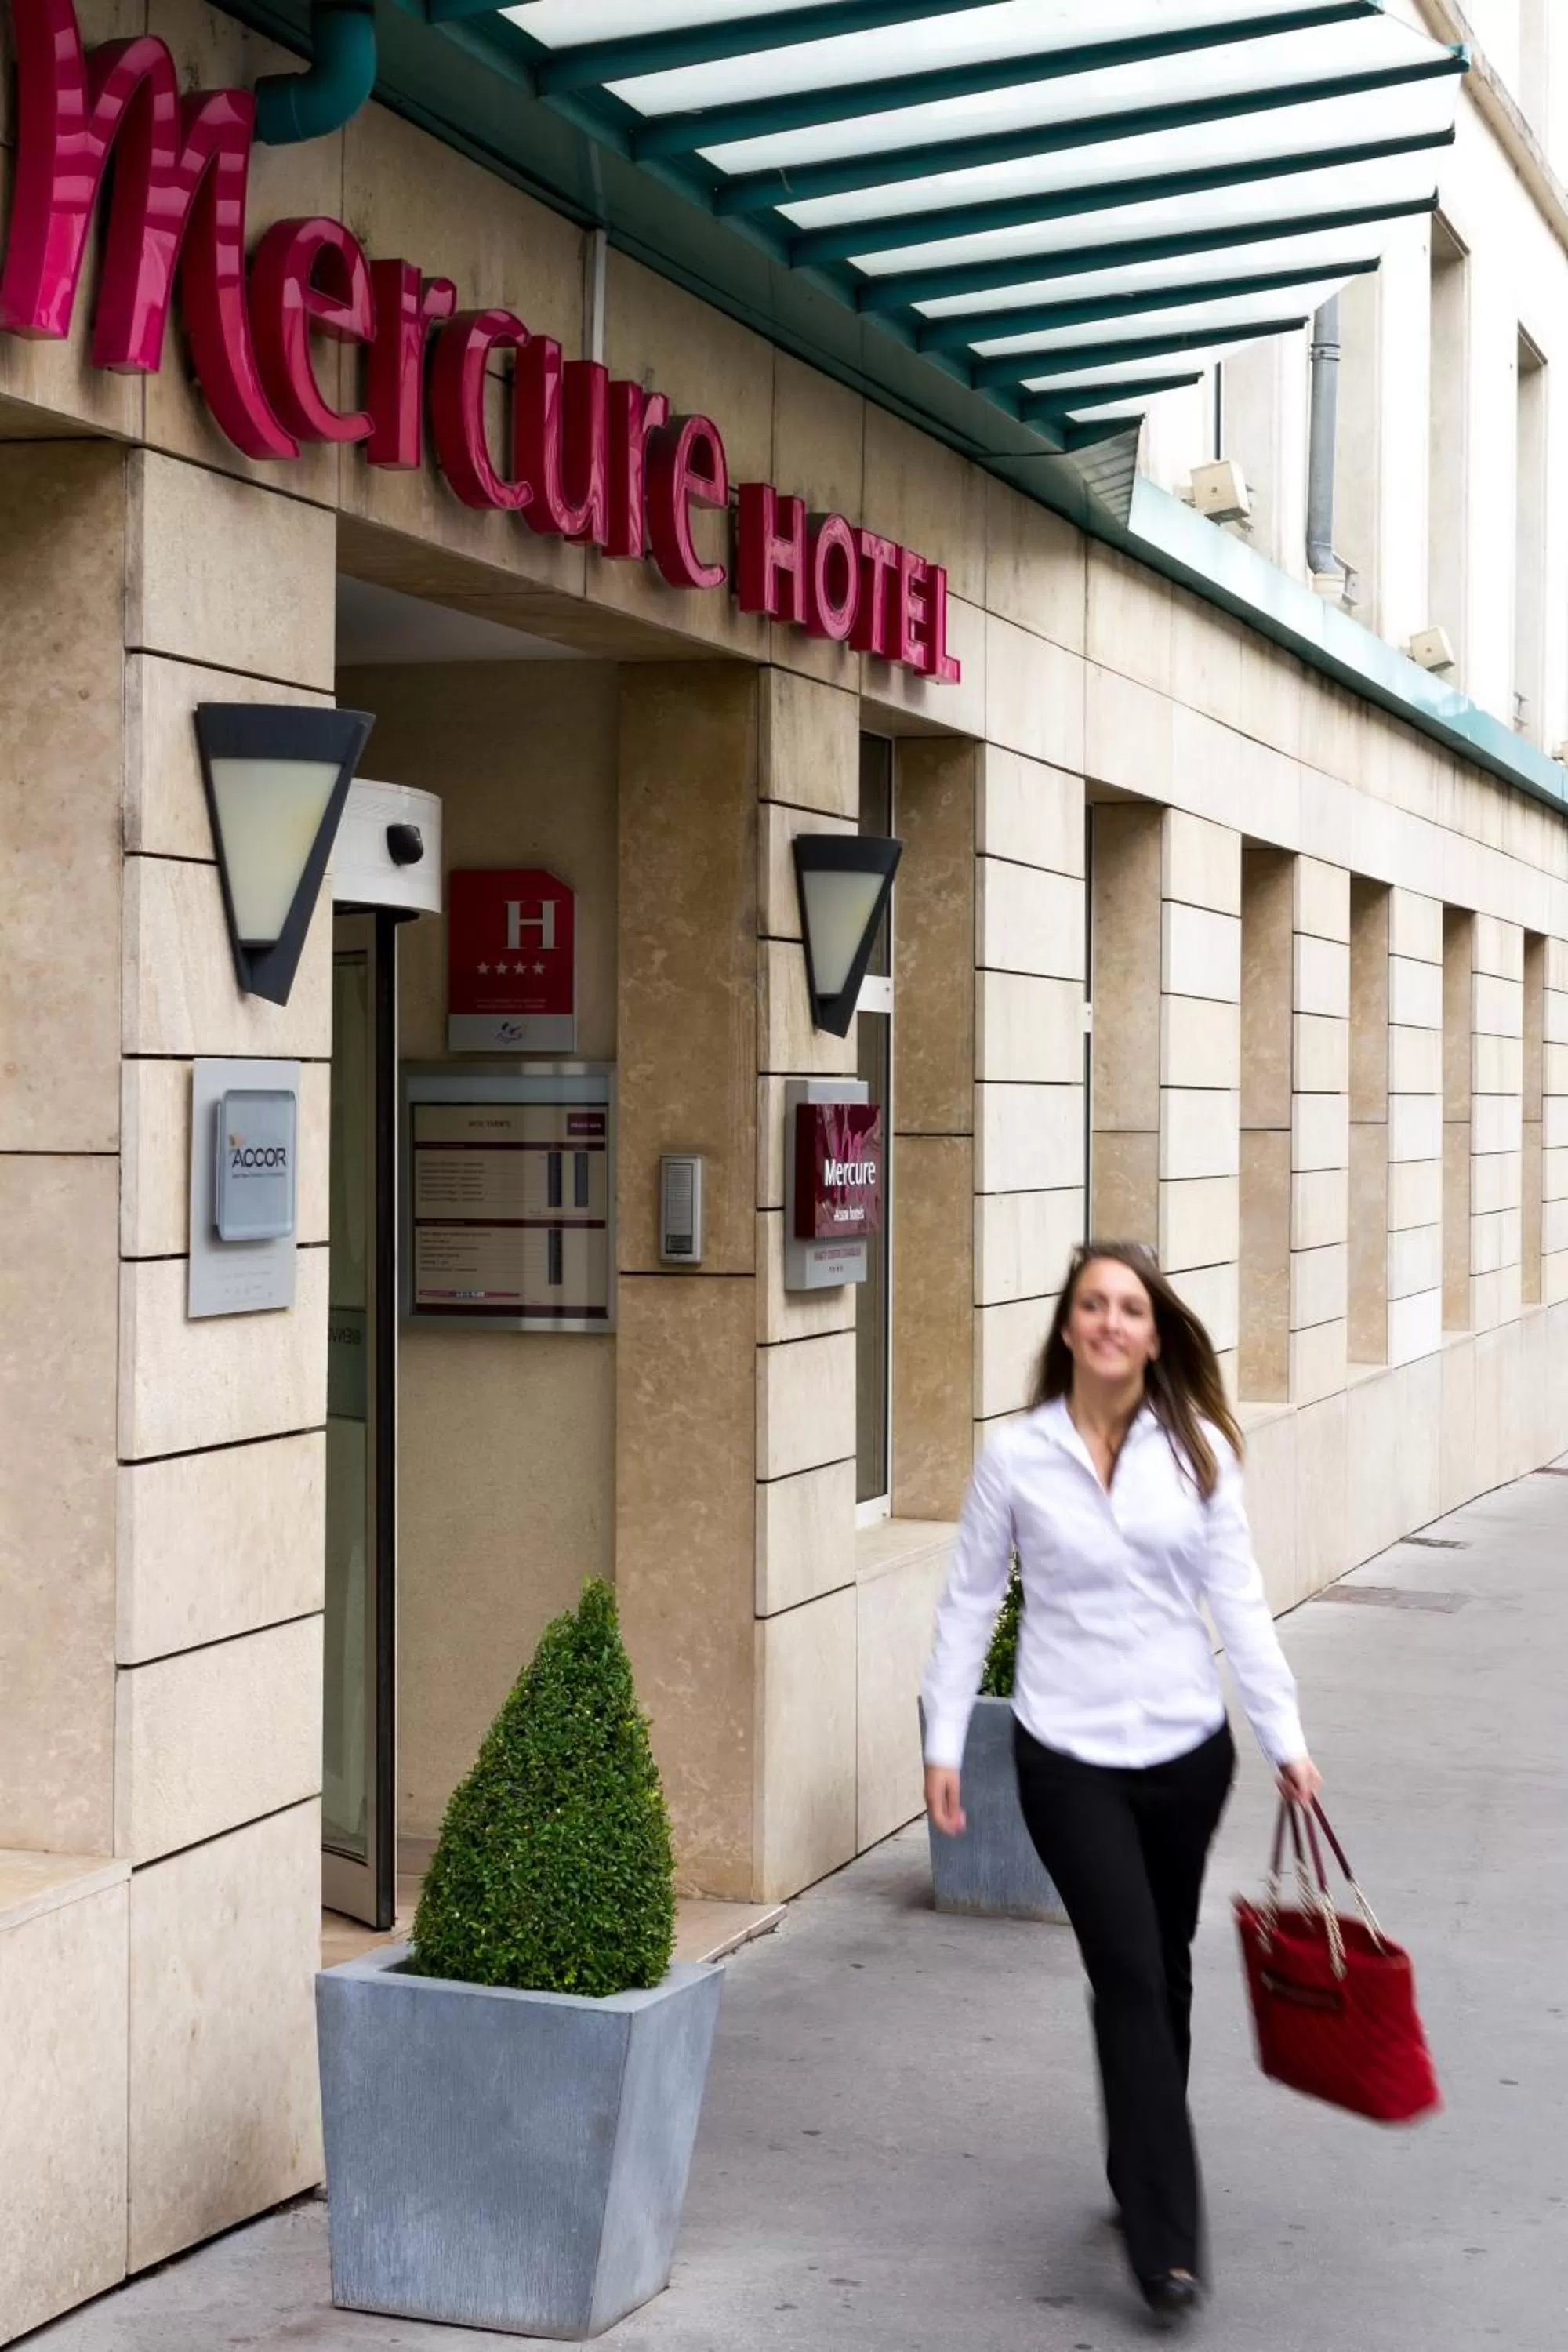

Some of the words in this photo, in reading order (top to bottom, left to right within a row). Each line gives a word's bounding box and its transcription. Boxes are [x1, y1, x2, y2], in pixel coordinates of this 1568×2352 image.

[3, 0, 729, 590] Mercure
[738, 482, 961, 685] HOTEL
[503, 900, 561, 949] H
[232, 1147, 286, 1167] ACCOR
[825, 1159, 876, 1186] Mercure
